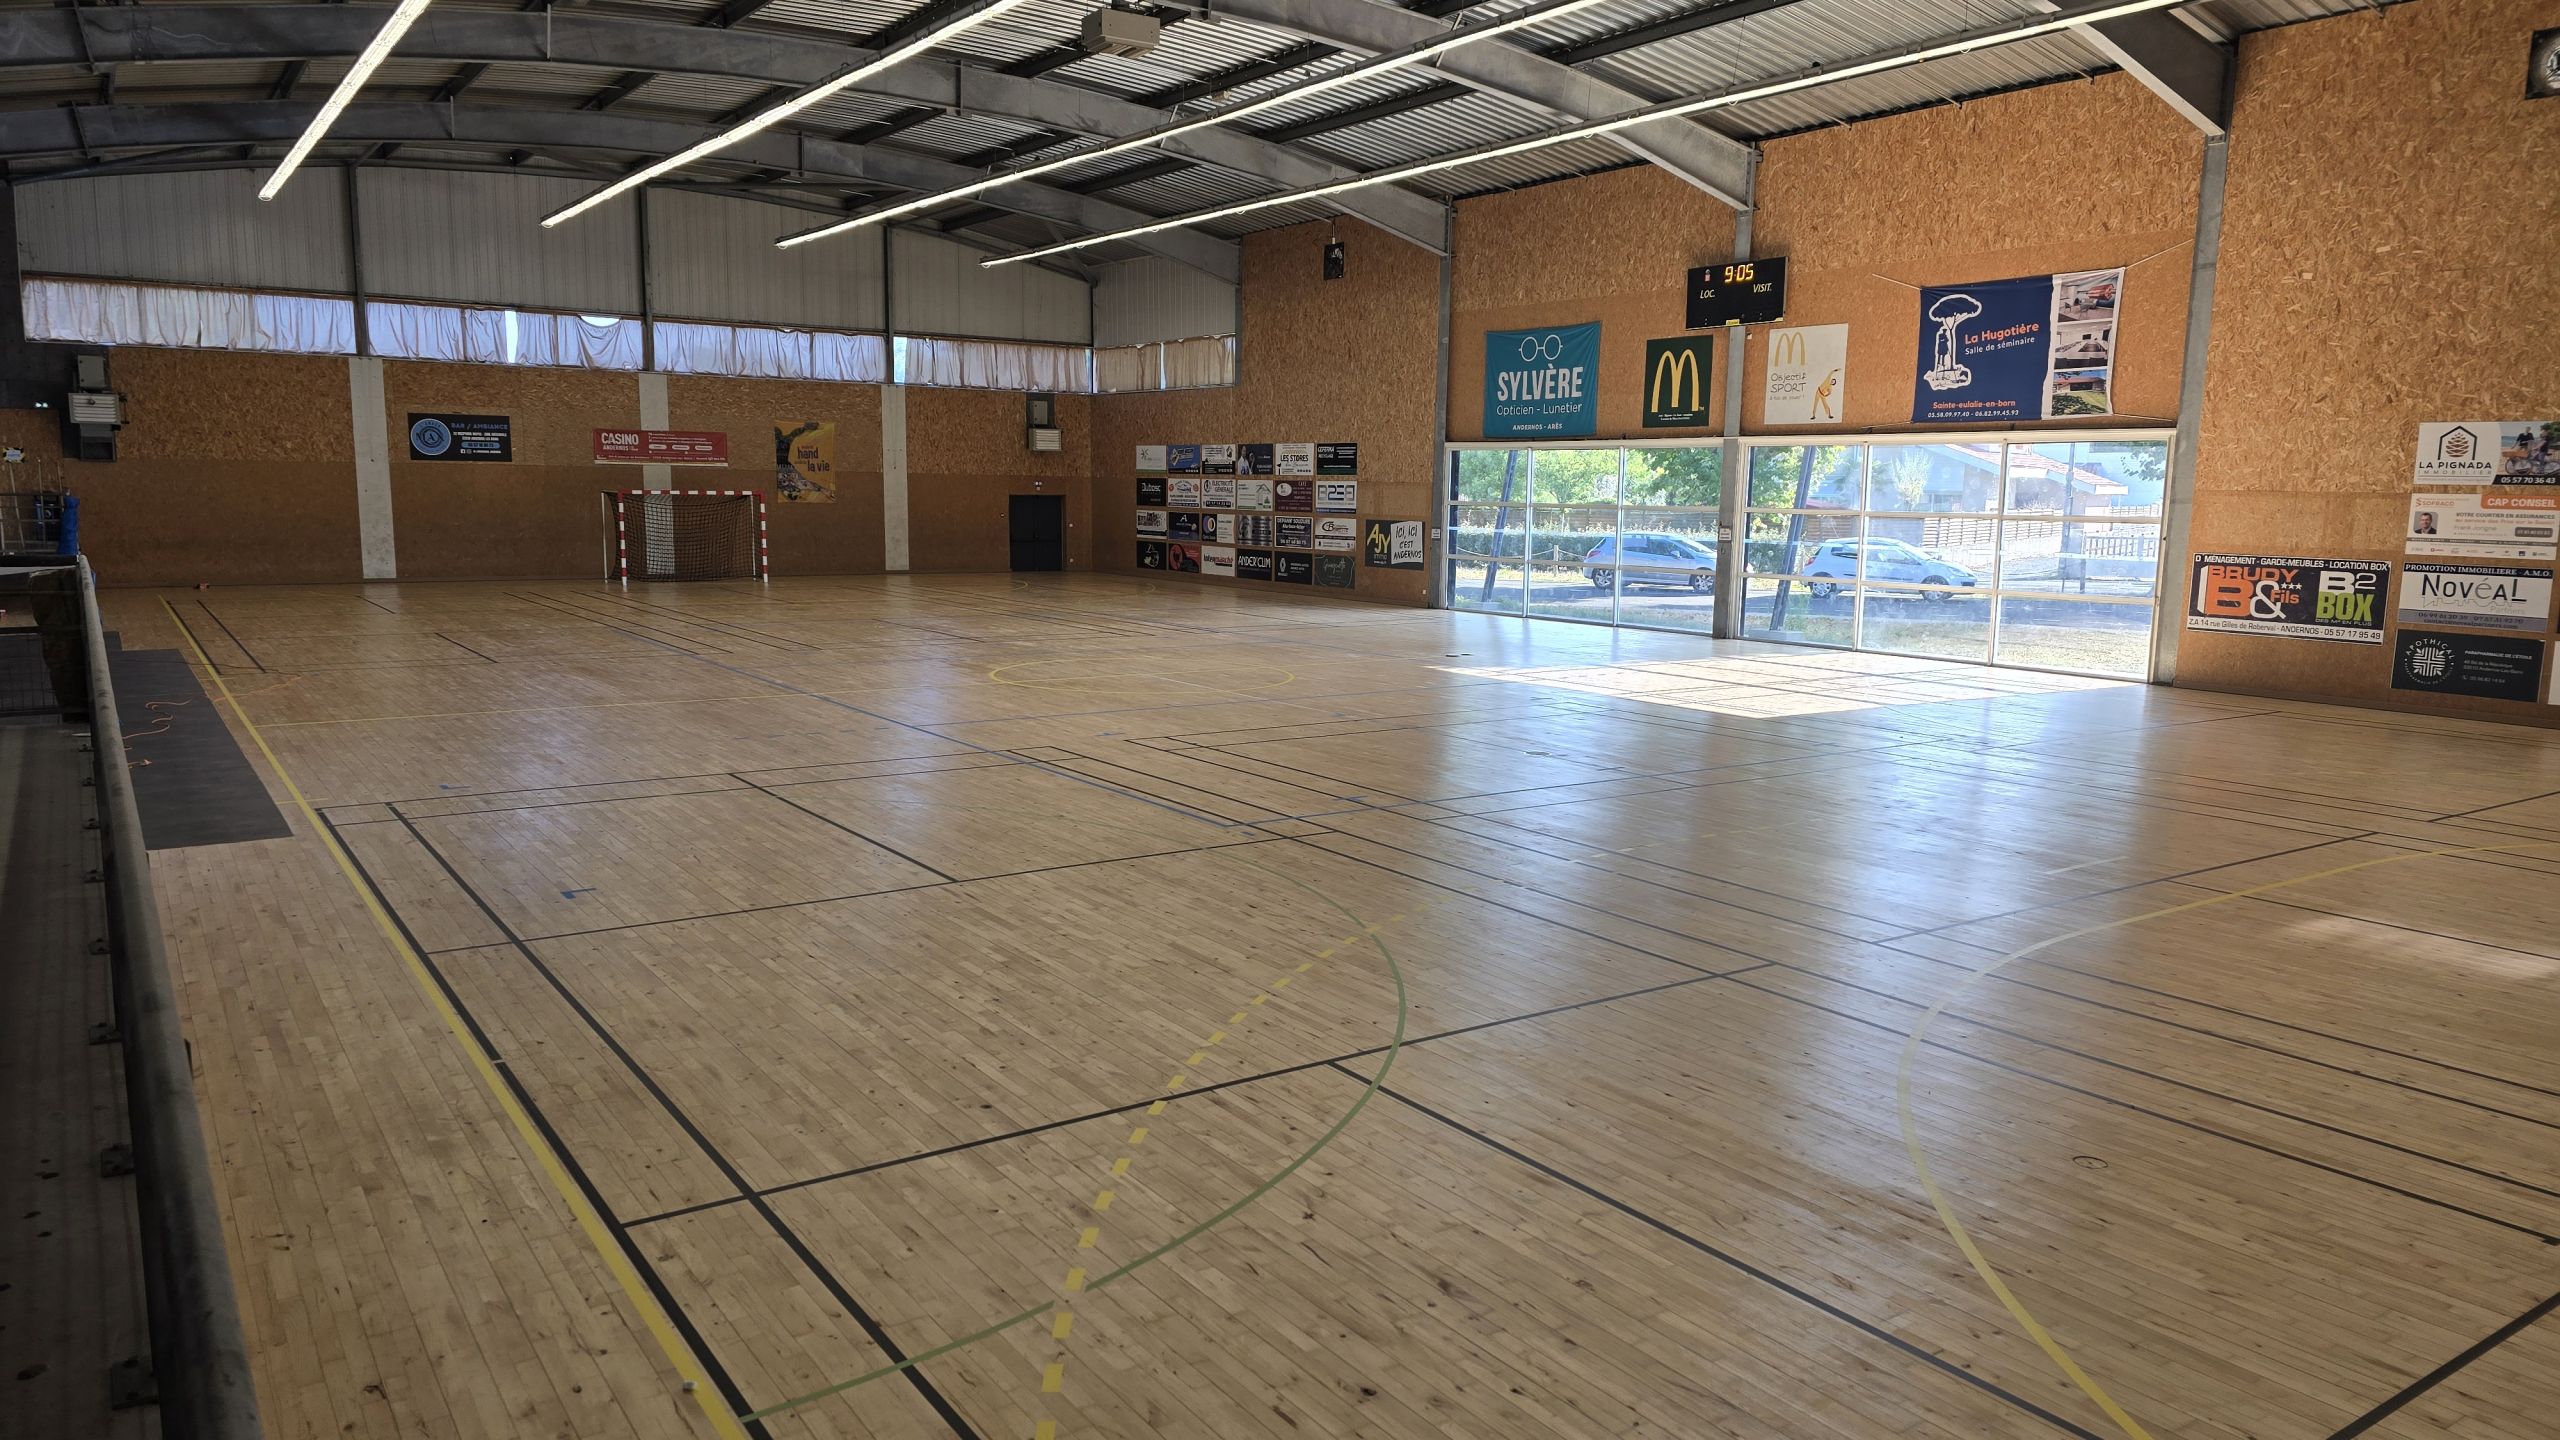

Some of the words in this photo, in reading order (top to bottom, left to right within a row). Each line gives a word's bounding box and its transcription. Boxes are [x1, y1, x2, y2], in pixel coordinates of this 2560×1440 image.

[1724, 263, 1754, 284] 9:05
[1964, 334, 1978, 345] La
[1981, 323, 2040, 342] Hugotière
[1965, 345, 1983, 355] Salle
[1985, 343, 1995, 352] de
[1997, 336, 2035, 350] séminaire
[1497, 363, 1583, 401] SYLVÈRE
[1770, 372, 1806, 385] Objectif
[1770, 383, 1807, 393] SPORT
[1496, 404, 1534, 417] Opticien
[1543, 402, 1583, 414] Lunetier
[1547, 422, 1563, 430] ARÈS
[601, 432, 640, 446] CASINO
[797, 447, 819, 459] hand
[1281, 454, 1289, 462] LES
[1290, 454, 1309, 462] STORES
[807, 460, 816, 472] la
[817, 460, 830, 472] vie
[2418, 461, 2434, 469] LA
[2438, 461, 2493, 470] PIGNADA
[2487, 498, 2509, 507] CAP
[2511, 498, 2557, 508] CONSEIL
[1367, 523, 1391, 554] AJY
[2260, 557, 2324, 568] GARDE-MEUBLES
[2329, 561, 2369, 570] LOCATION
[2370, 562, 2388, 571] BOX
[2405, 564, 2457, 573] PROMOTION
[2458, 566, 2518, 576] IMMOBILIERE
[2523, 569, 2552, 577] A.M.O.
[2270, 588, 2300, 605] Fils
[2316, 591, 2375, 622] BOX
[2222, 621, 2238, 629] Gilles
[2248, 622, 2276, 631] Roberval
[2280, 625, 2320, 635] ANDERNOS
[2335, 629, 2345, 637] 57
[2359, 631, 2369, 639] 95
[2370, 632, 2381, 640] 49
[2405, 638, 2457, 660] APOTHICAL
